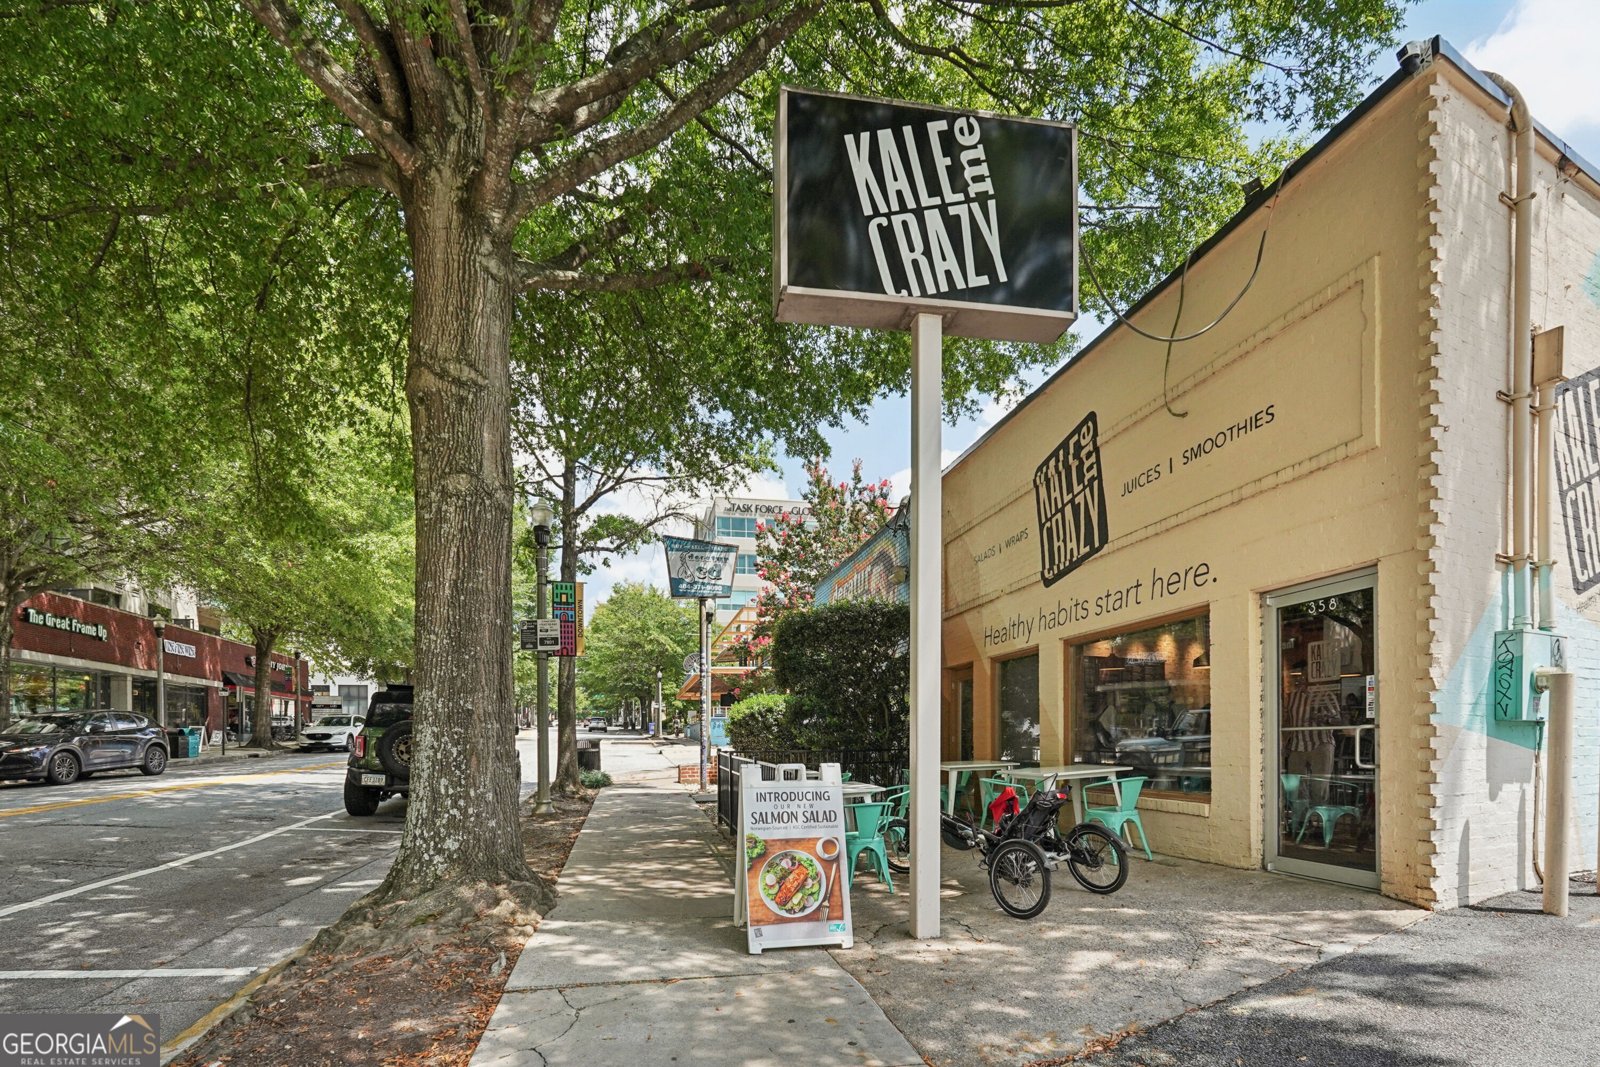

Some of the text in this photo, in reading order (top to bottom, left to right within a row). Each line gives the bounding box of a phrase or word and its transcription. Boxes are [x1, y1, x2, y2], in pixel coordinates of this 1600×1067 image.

[844, 115, 994, 216] KALE me
[868, 199, 1008, 297] CRAZY
[1036, 433, 1084, 524] KALE
[1121, 464, 1161, 497] JUICES
[1182, 404, 1275, 466] SMOOTHIES
[731, 503, 753, 514] TASK
[755, 504, 784, 514] FORCE
[791, 506, 810, 516] GLO
[1042, 480, 1100, 580] CRAZY
[974, 545, 996, 565] SALADS
[1005, 527, 1029, 549] WRAPS
[28, 608, 107, 642] The Great Frame Up
[984, 562, 1218, 648] Healthy habits start here.
[1308, 598, 1337, 614] 358
[751, 810, 837, 825] SALMON SALAD
[756, 791, 831, 802] INTRODUCING
